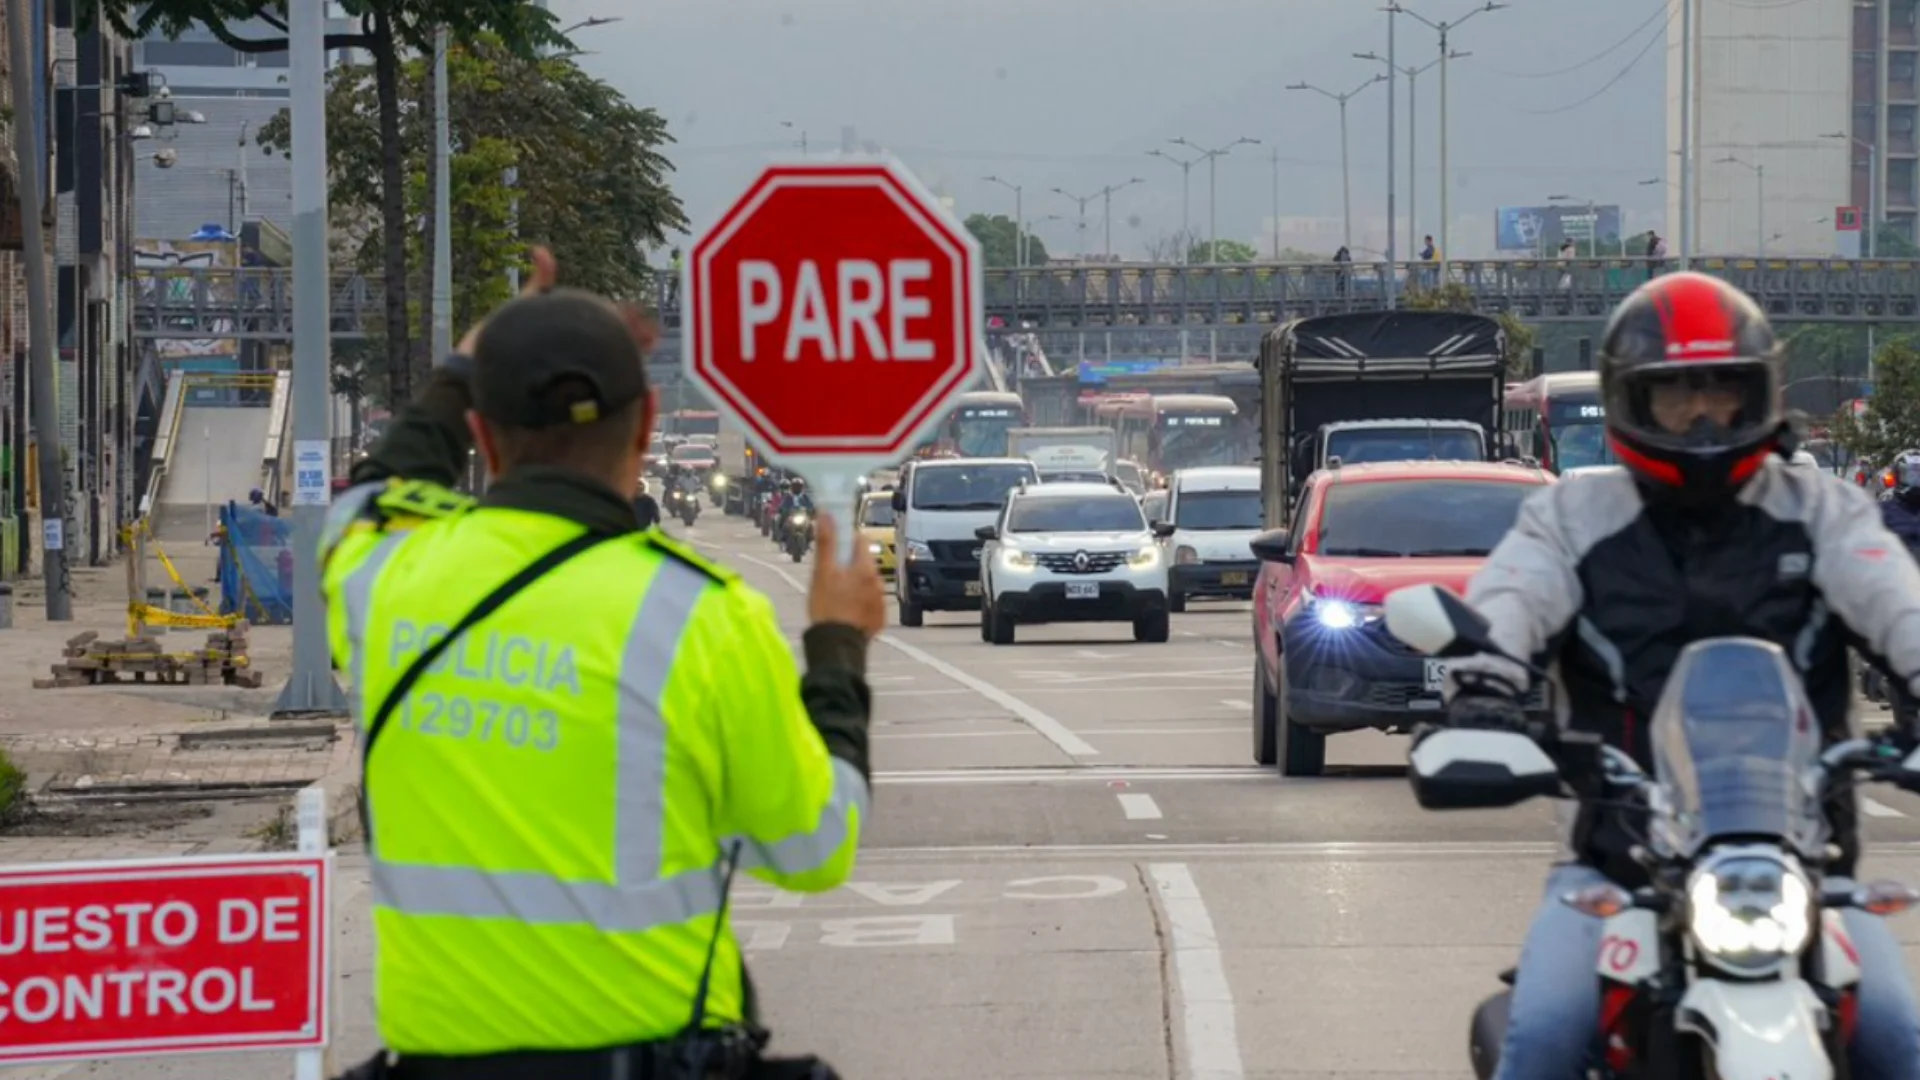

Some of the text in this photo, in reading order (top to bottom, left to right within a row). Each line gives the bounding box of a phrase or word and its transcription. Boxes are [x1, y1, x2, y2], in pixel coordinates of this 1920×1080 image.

[737, 258, 936, 362] PARE
[389, 619, 582, 696] POLICIA
[399, 690, 560, 752] 129703
[217, 896, 301, 944] DE
[0, 967, 275, 1025] ONTROL
